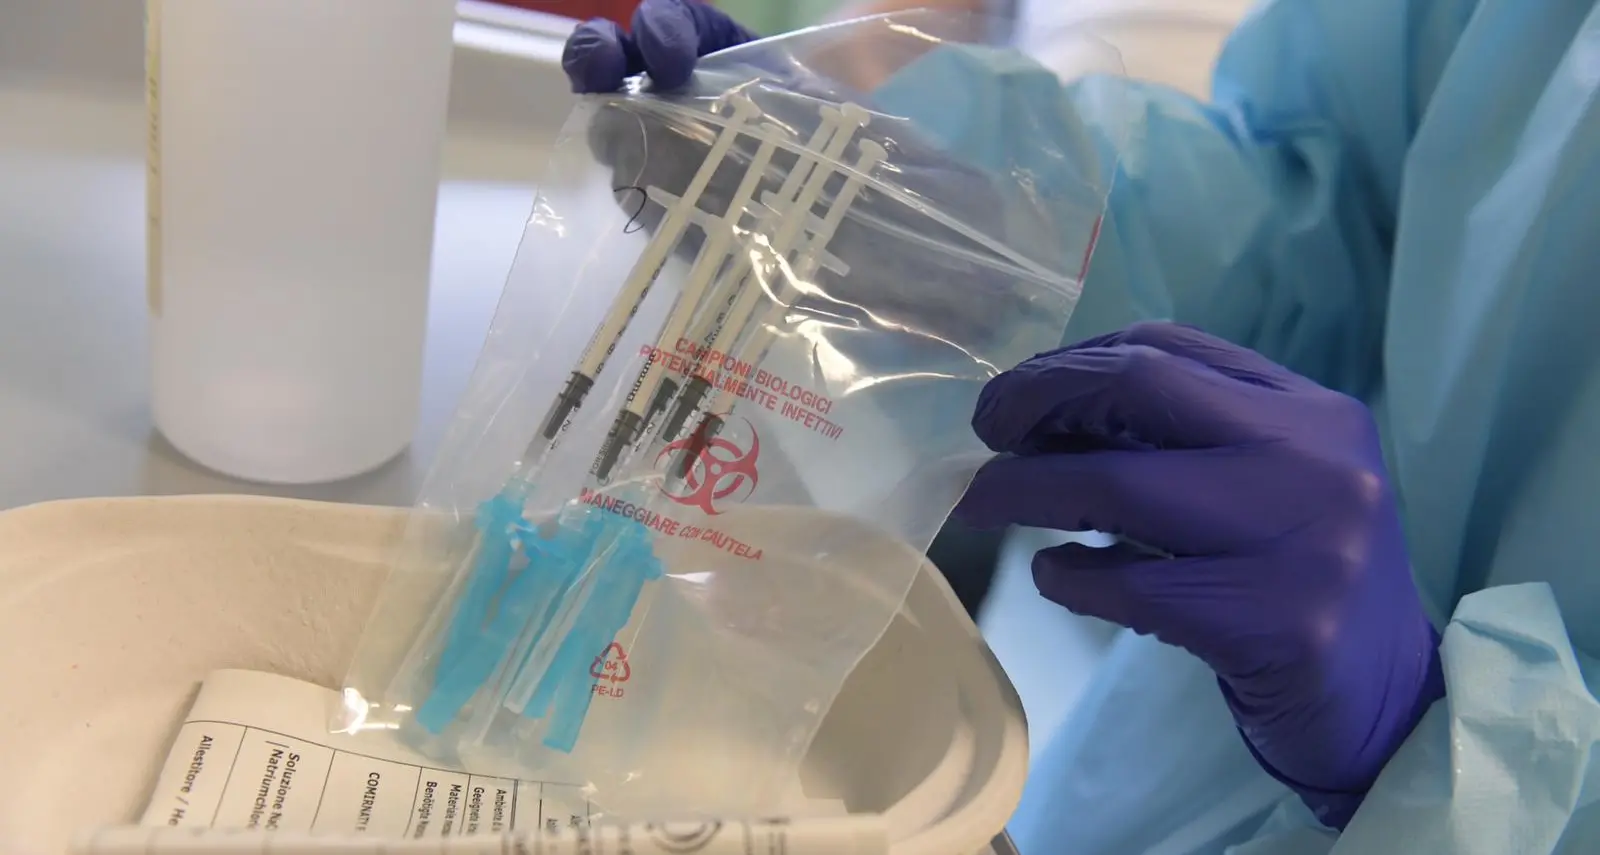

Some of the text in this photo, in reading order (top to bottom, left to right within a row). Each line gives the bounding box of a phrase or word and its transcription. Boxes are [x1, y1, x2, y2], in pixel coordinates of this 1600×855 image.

[640, 344, 776, 411] POTENZIALMENTE
[781, 402, 844, 440] INFETTIVI
[674, 337, 752, 378] CAMPIONI
[755, 367, 832, 413] BIOLOGICI
[580, 488, 681, 537] MANEGGIARE
[701, 528, 763, 561] CAUTELA
[591, 684, 624, 698] PE-LD
[181, 735, 213, 793] Allestitore
[272, 753, 300, 810] Soluzione
